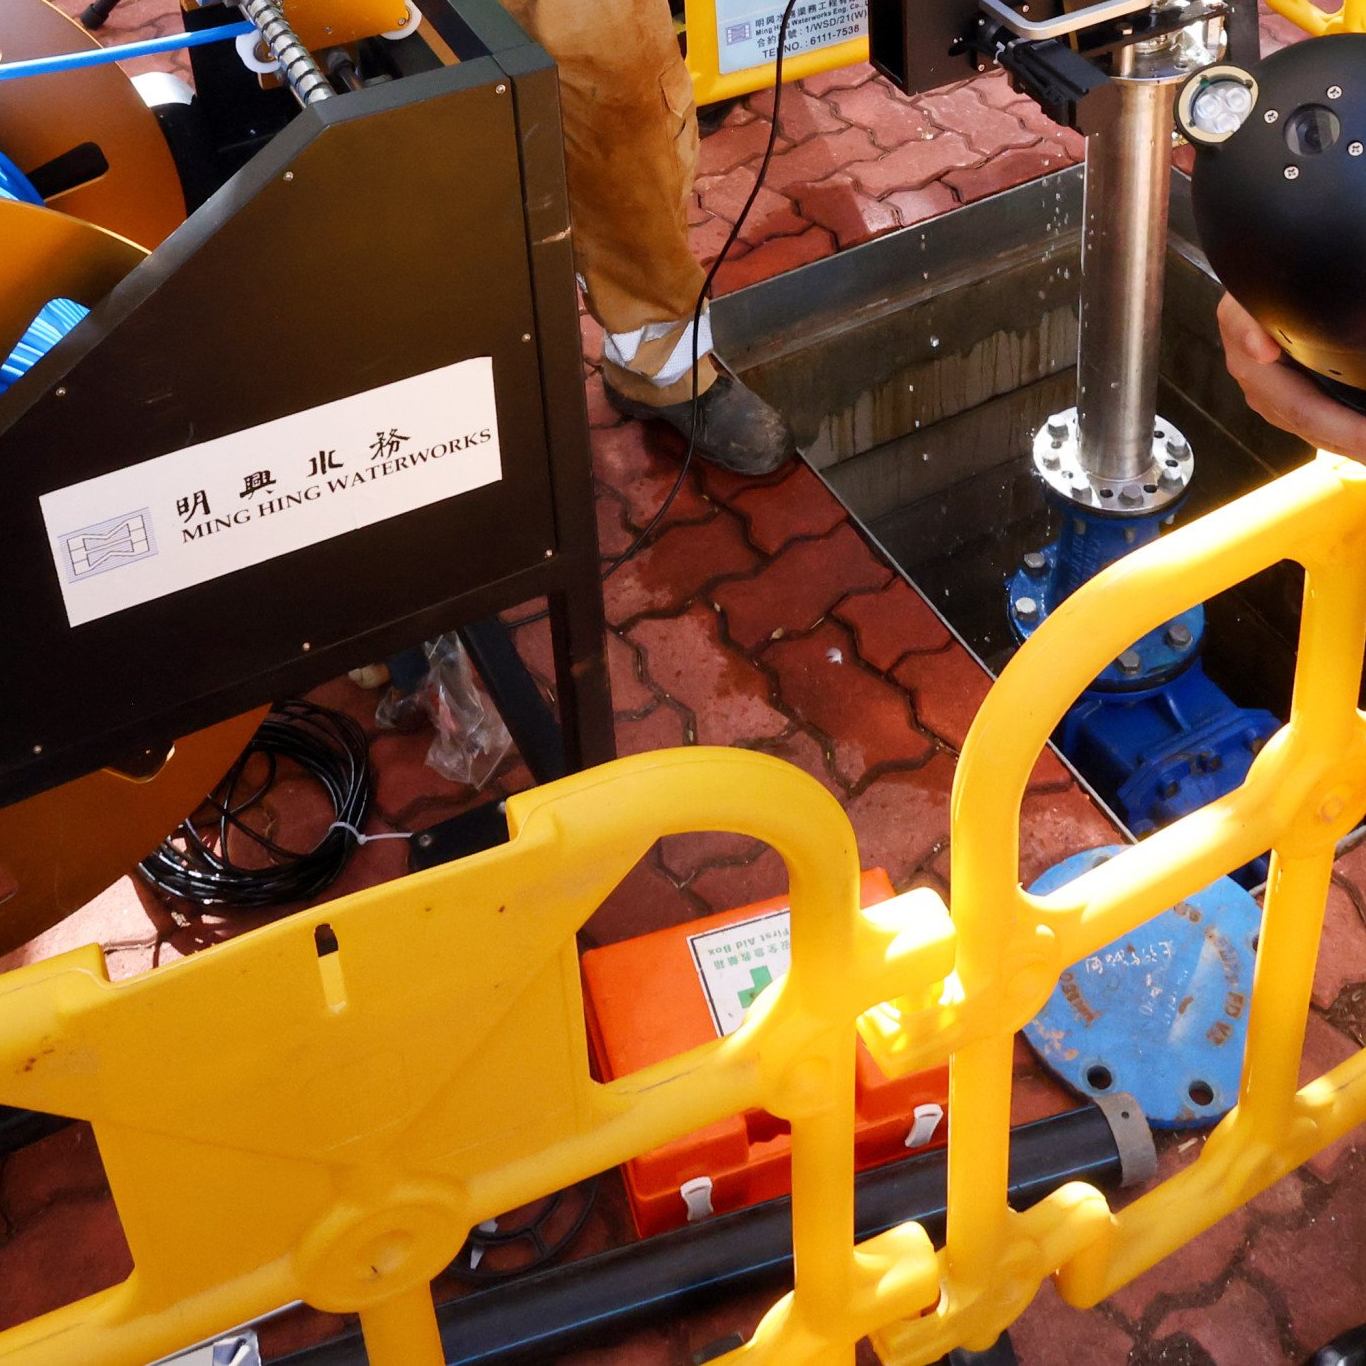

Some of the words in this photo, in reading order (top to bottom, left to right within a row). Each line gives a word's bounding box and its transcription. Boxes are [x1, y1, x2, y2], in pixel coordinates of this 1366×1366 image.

[774, 23, 791, 32] Hg
[791, 10, 832, 26] Waterworks
[762, 47, 779, 59] TE
[810, 24, 860, 45] 6111-7538
[175, 428, 410, 523] 明興水務
[182, 508, 252, 544] MING
[256, 485, 322, 518] HING
[327, 428, 492, 494] WATERWORKS
[735, 937, 756, 949] Aid
[759, 928, 790, 941] First
[707, 944, 732, 956] Box
